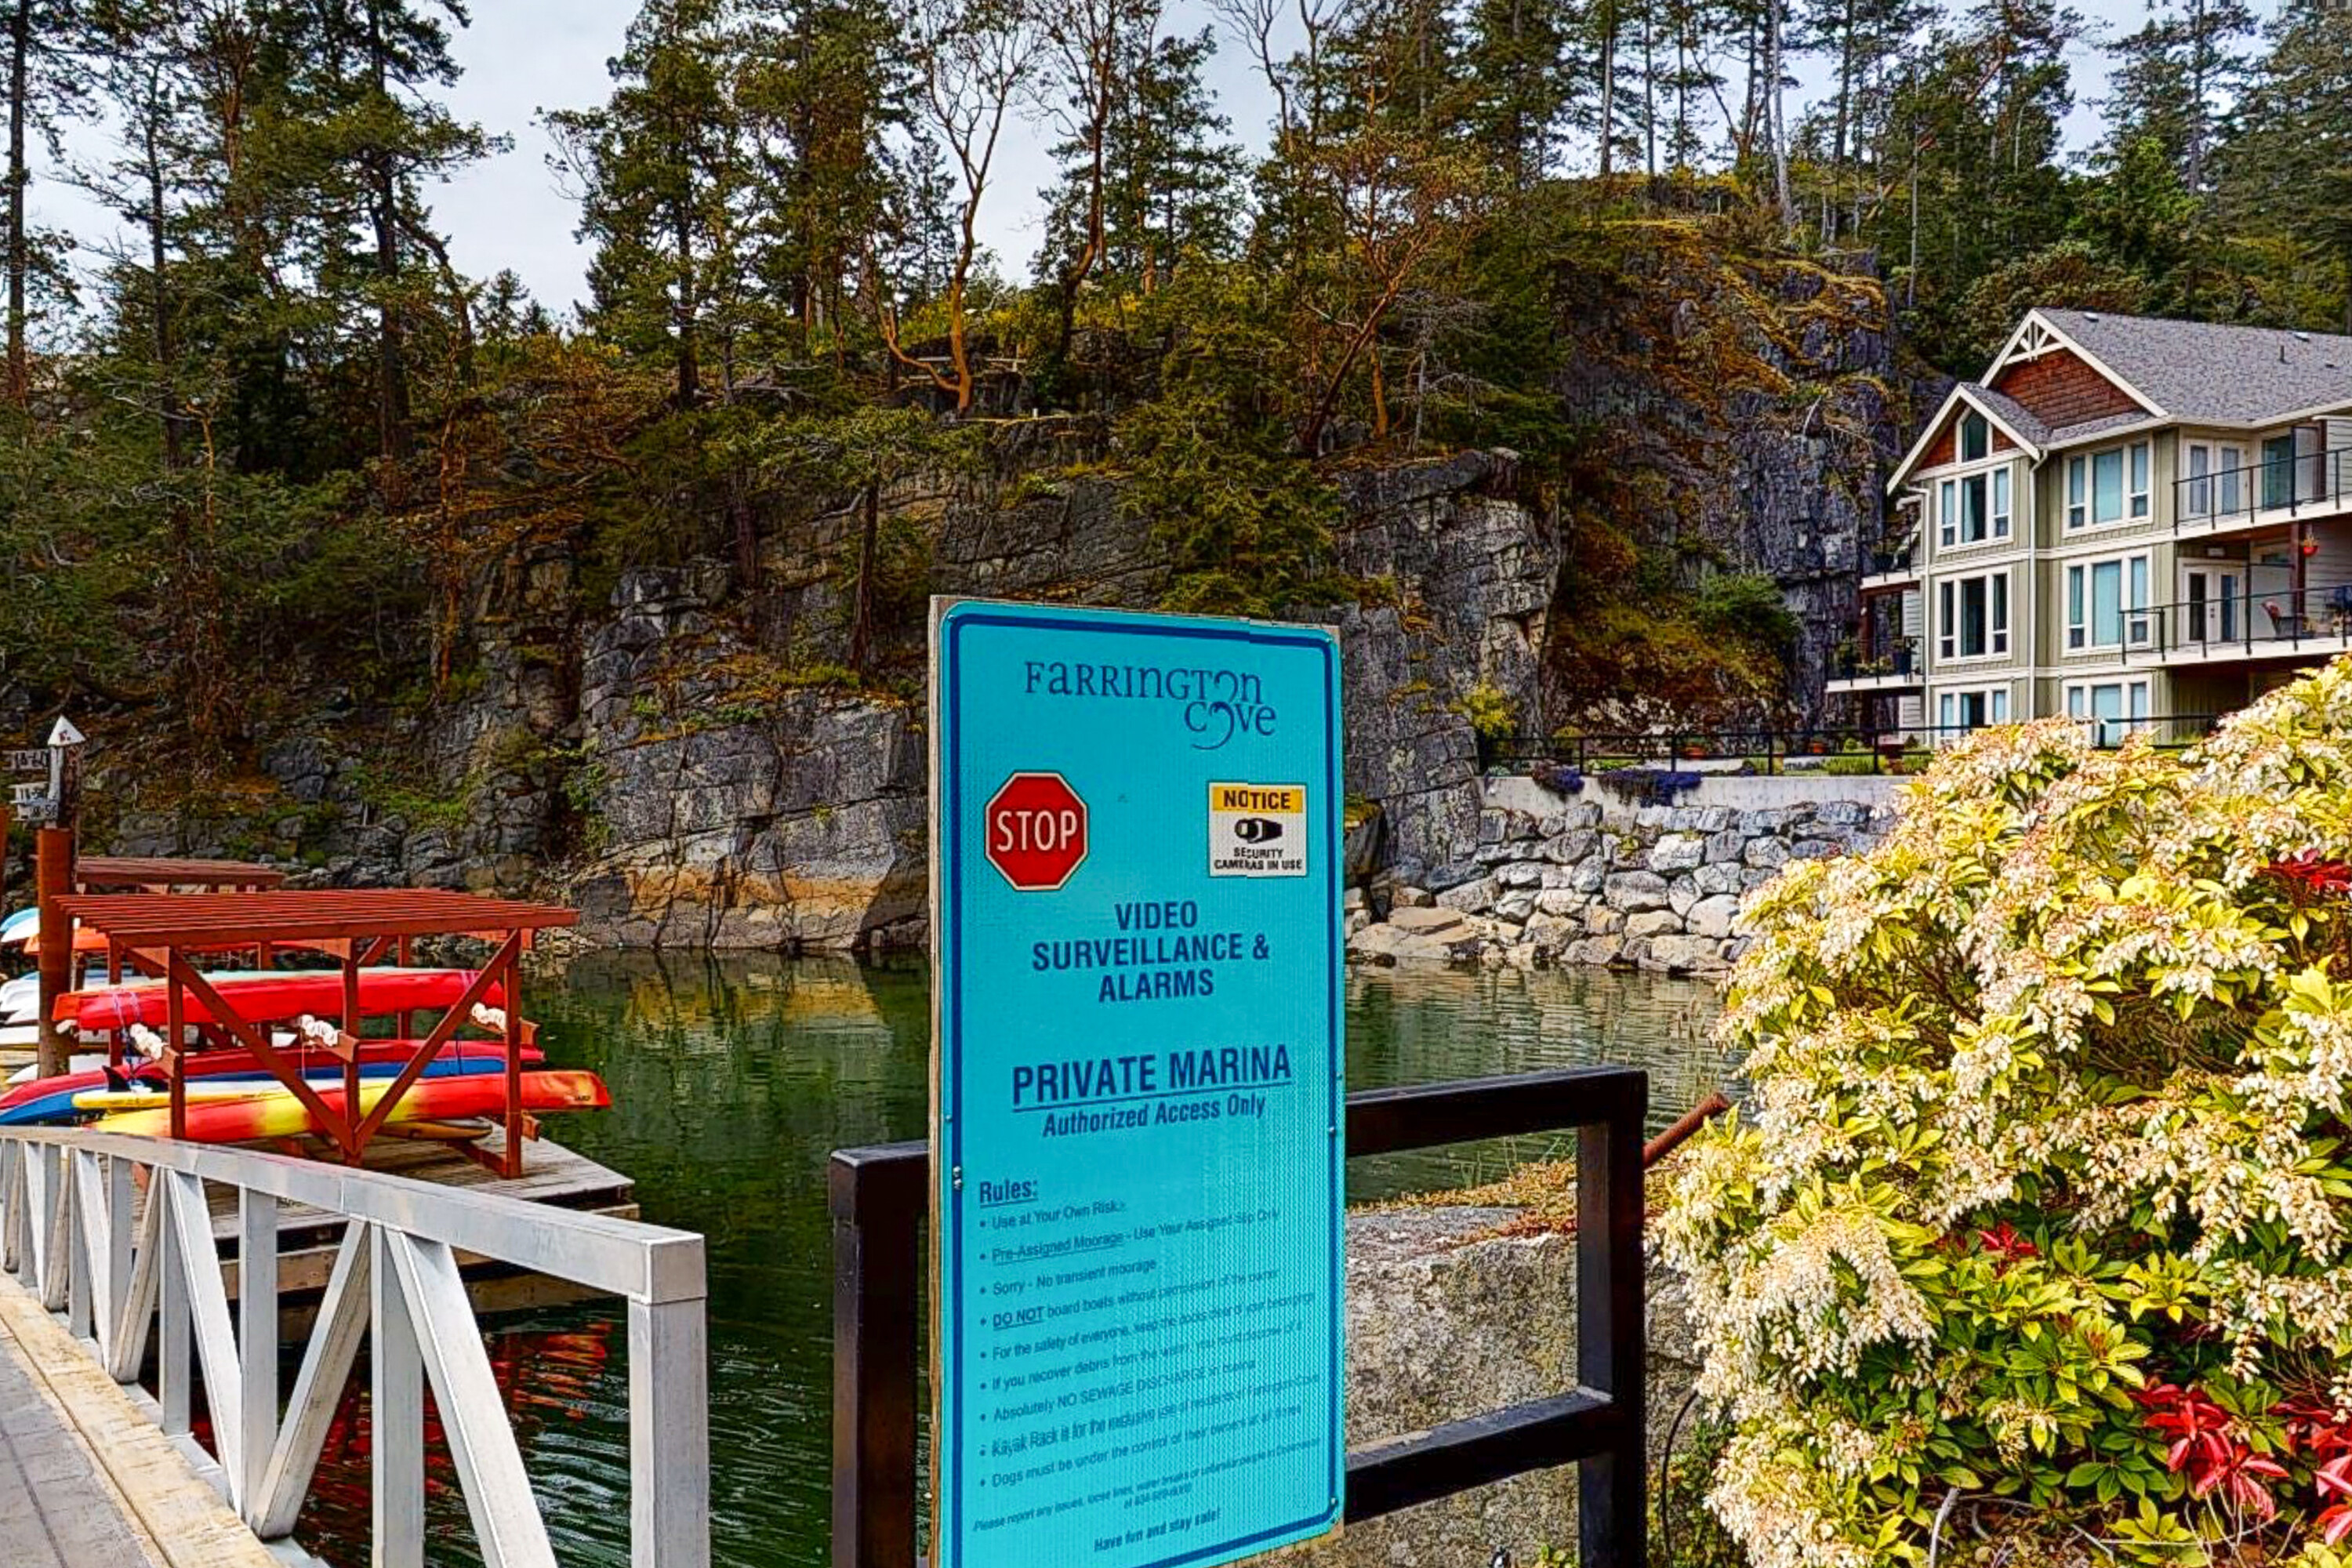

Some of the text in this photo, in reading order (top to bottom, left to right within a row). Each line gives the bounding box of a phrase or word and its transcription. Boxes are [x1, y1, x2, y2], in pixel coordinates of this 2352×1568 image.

[1223, 789, 1291, 810] NOTICE
[996, 809, 1078, 853] STOP
[1214, 858, 1302, 870] CAMERAS IN USE
[1233, 847, 1284, 859] SECURITY
[1114, 900, 1198, 931] VIDEO
[1033, 932, 1270, 971] SURVEILLANCE &
[1098, 969, 1214, 1003] ALARMS
[1011, 1044, 1292, 1105] PRIVATE MARINA
[1043, 1093, 1266, 1138] Authorized Access Only
[980, 1178, 1038, 1203] Rules:
[993, 1216, 1016, 1229] Use
[1020, 1214, 1030, 1224] at
[1035, 1209, 1060, 1223] Your
[1064, 1205, 1090, 1218] Own
[993, 1240, 1071, 1261] Pre-Assigned
[1076, 1232, 1123, 1250] Moorage
[1134, 1226, 1155, 1239] Use
[993, 1279, 1025, 1298] Sorry
[1037, 1274, 1053, 1287] No
[1056, 1269, 1105, 1283] transient
[1109, 1261, 1156, 1277] moorage
[993, 1312, 1012, 1327] DO
[1017, 1307, 1044, 1321] NOT
[1048, 1301, 1079, 1316] board
[993, 1345, 1011, 1359] For
[1014, 1342, 1031, 1355] the
[1035, 1337, 1065, 1353] safety
[1068, 1333, 1079, 1345] of
[993, 1377, 1000, 1390] If
[1004, 1377, 1025, 1390] you
[1029, 1368, 1071, 1382] recover
[1075, 1359, 1109, 1373] debris
[995, 1398, 1054, 1422] Absolutely
[1058, 1393, 1076, 1407] NO
[1081, 1382, 1134, 1403] SEWAGE
[993, 1469, 1022, 1488] Dogs
[1026, 1463, 1054, 1478] must
[1059, 1458, 1072, 1471] be
[1094, 1534, 1122, 1552] Have
[1126, 1528, 1143, 1544] fun
[1146, 1523, 1166, 1538] and
[1170, 1516, 1192, 1534] stay
